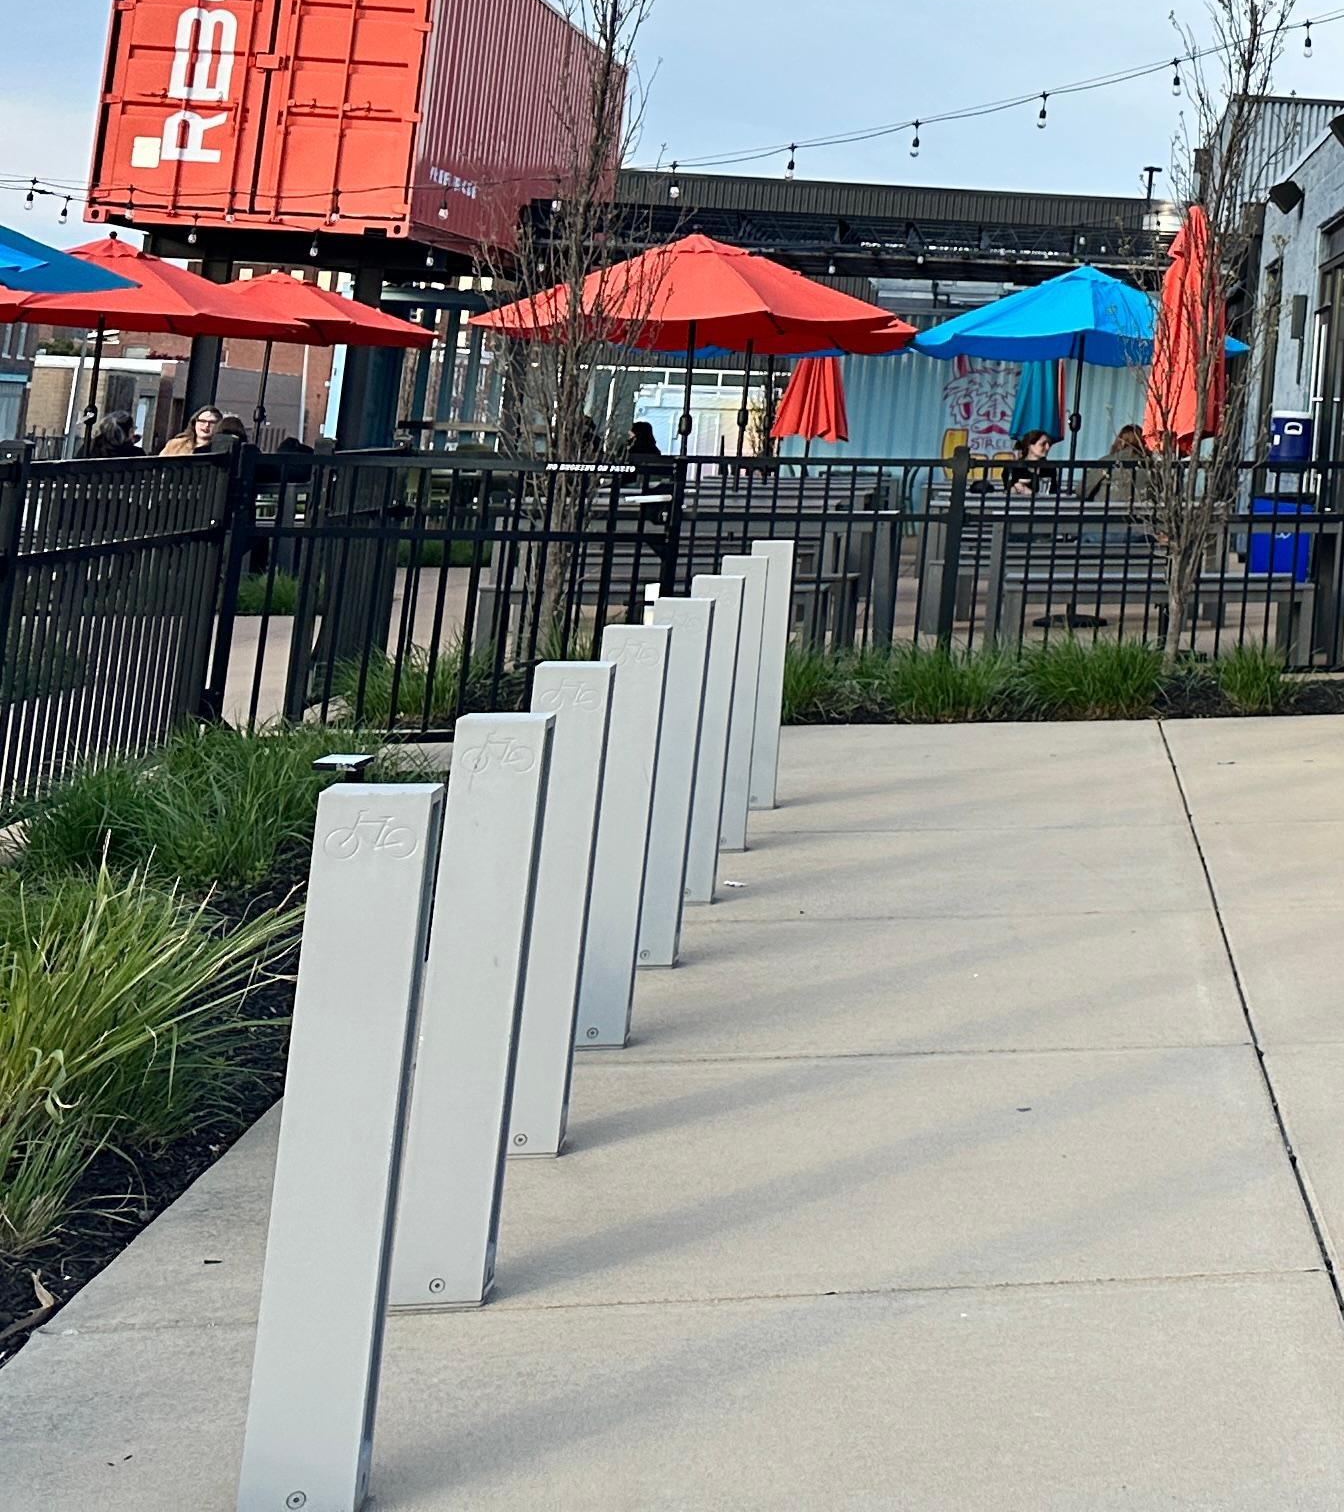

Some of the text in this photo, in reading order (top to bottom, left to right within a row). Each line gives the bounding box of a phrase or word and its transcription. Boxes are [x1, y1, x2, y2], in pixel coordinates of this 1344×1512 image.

[546, 463, 558, 471] NO
[597, 464, 608, 472] ON
[610, 464, 636, 473] PATIO
